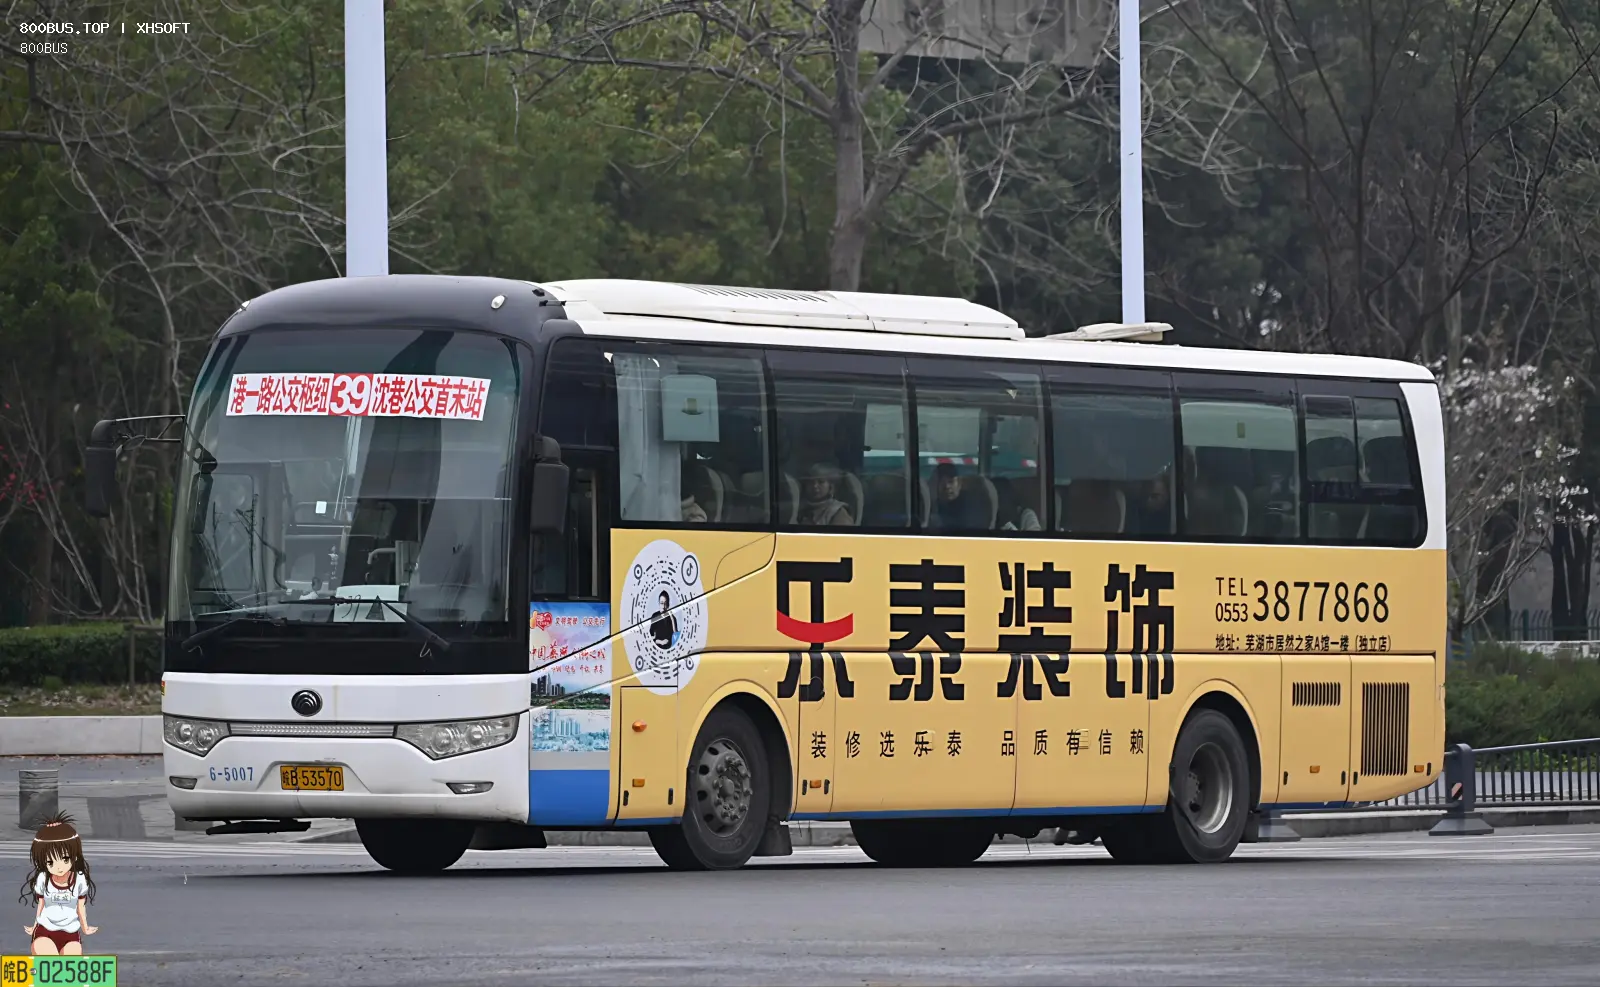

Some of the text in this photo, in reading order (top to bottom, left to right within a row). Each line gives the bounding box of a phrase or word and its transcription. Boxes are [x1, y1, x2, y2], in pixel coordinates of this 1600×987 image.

[230, 374, 486, 419] 港一路公交枢纽 39 沈巷公交首末站
[1215, 576, 1248, 597] TEL
[1215, 579, 1390, 624] 0553 3877868
[775, 556, 1176, 702] 乐泰装饰
[811, 729, 1144, 759] 装修选乐泰 品质有信赖
[209, 766, 254, 783] 6-5007
